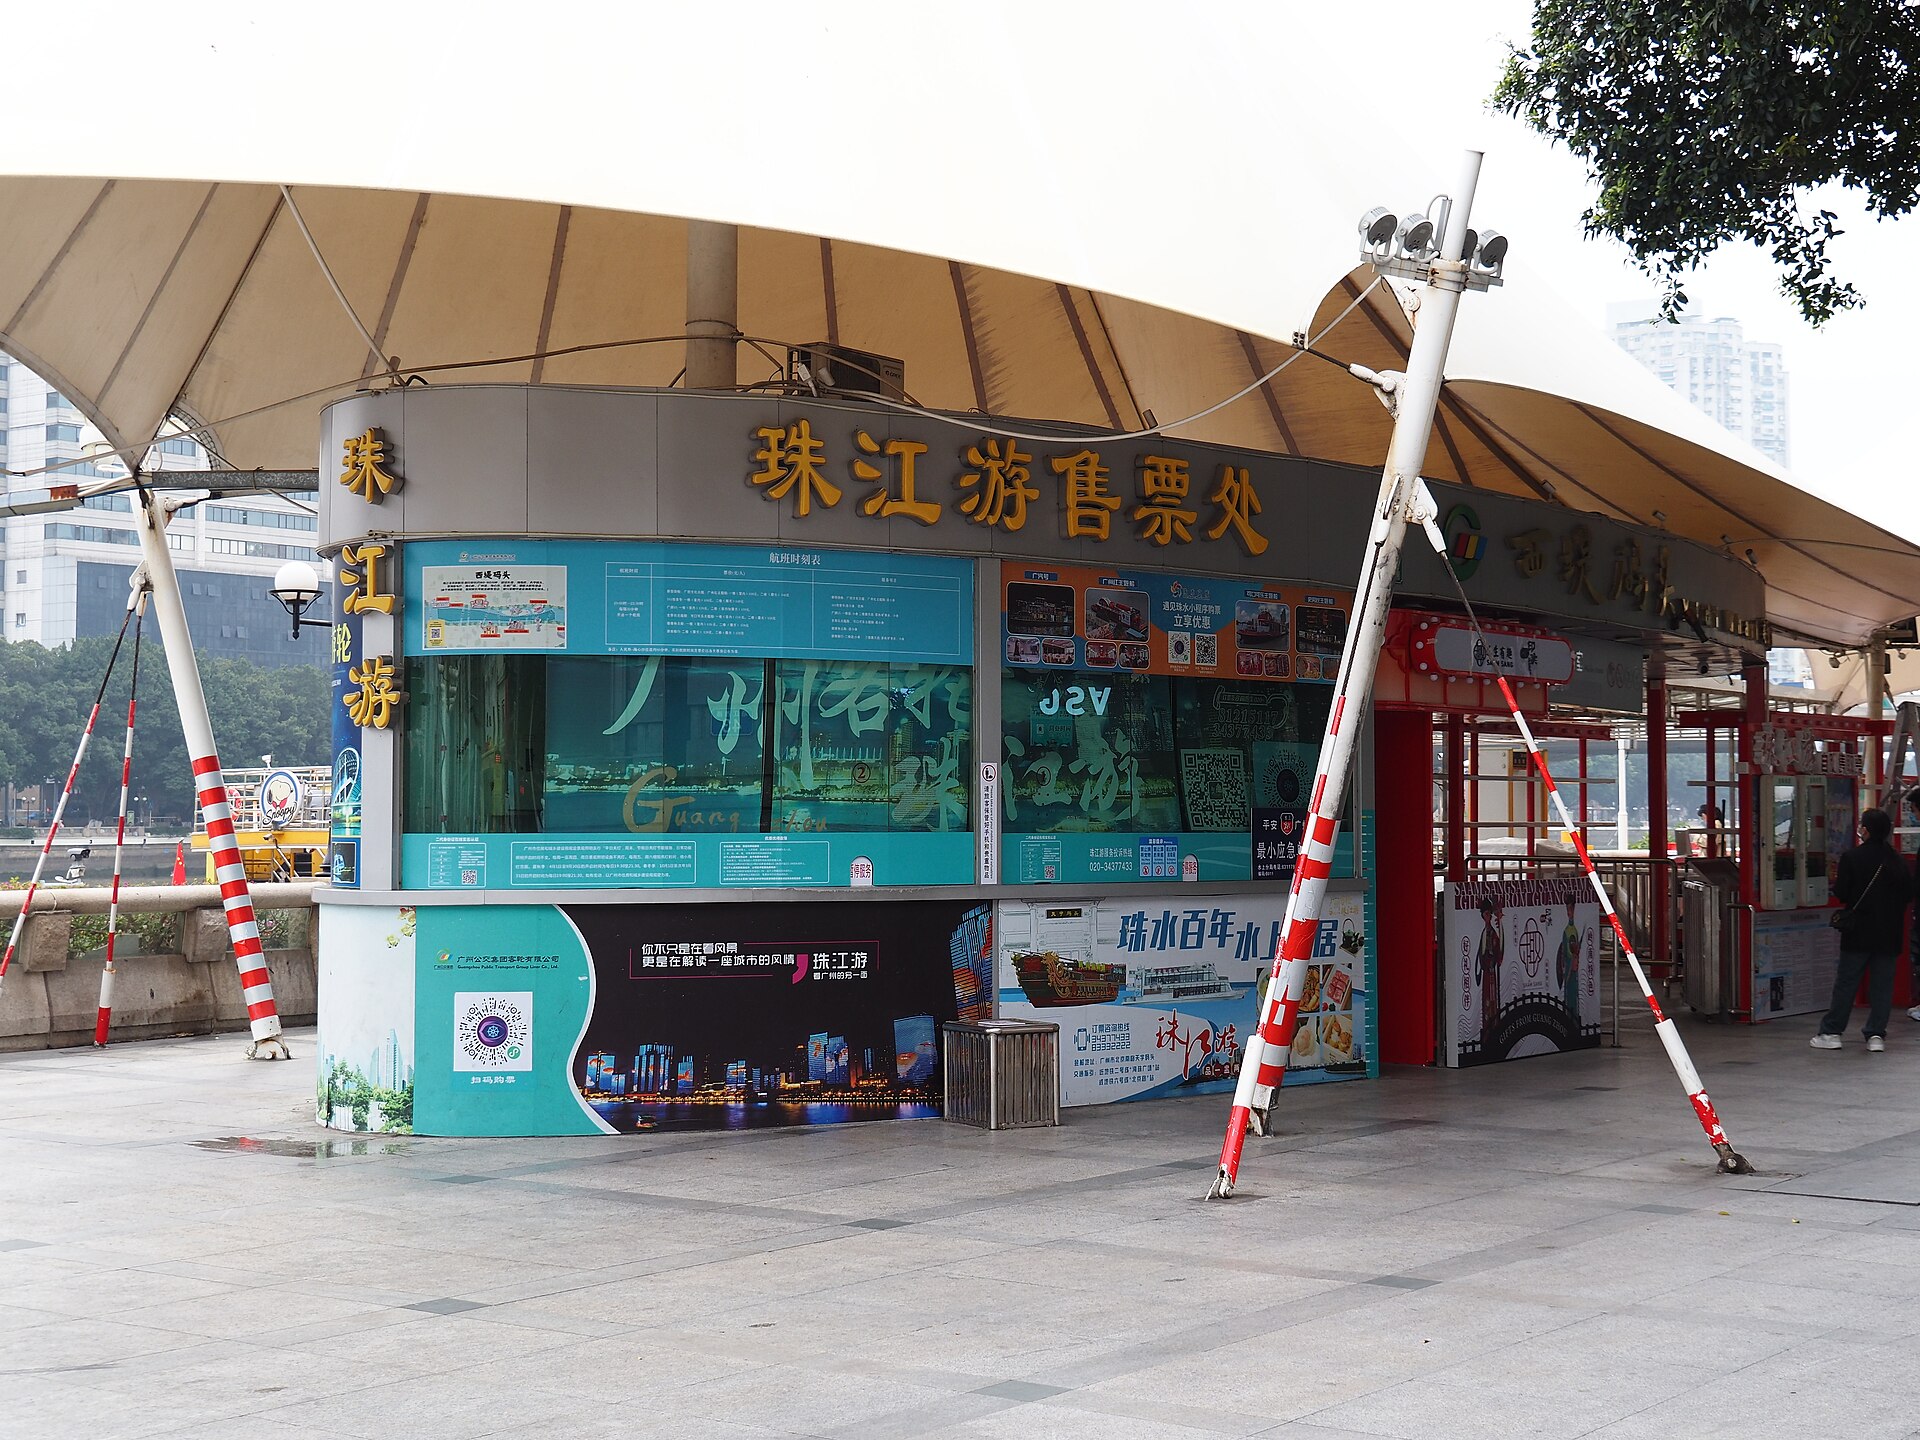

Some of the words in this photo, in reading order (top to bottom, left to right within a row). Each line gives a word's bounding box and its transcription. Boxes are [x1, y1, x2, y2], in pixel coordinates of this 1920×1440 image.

[752, 418, 1270, 557] 珠江游售票处
[769, 552, 821, 565] 航班时刻表
[340, 427, 401, 729] 珠江游
[475, 570, 511, 580] 西堤码头
[1162, 601, 1221, 615] 遇见珠水小程序购票
[1174, 614, 1211, 629] 立享优惠
[331, 622, 352, 664] 轮
[262, 801, 298, 826] Snoopy
[1262, 819, 1278, 831] 平安
[1089, 847, 1133, 858] 珠江游服务投诉热线
[1089, 861, 1133, 872] 020-34377433
[1117, 908, 1236, 952] 珠水百年
[641, 942, 738, 956] 你不只是在看风景
[456, 955, 560, 963] 广州公交集团客轮有限公司
[642, 954, 795, 968] 更是在解读一座城市的风情
[812, 951, 868, 970] 珠江游
[813, 971, 868, 980] 看广州的另一面
[1091, 1022, 1130, 1034] 订票咨询热线
[1091, 1032, 1131, 1044] 34377433
[1091, 1041, 1131, 1052] 83332222
[470, 1075, 516, 1084] 扫码购票
